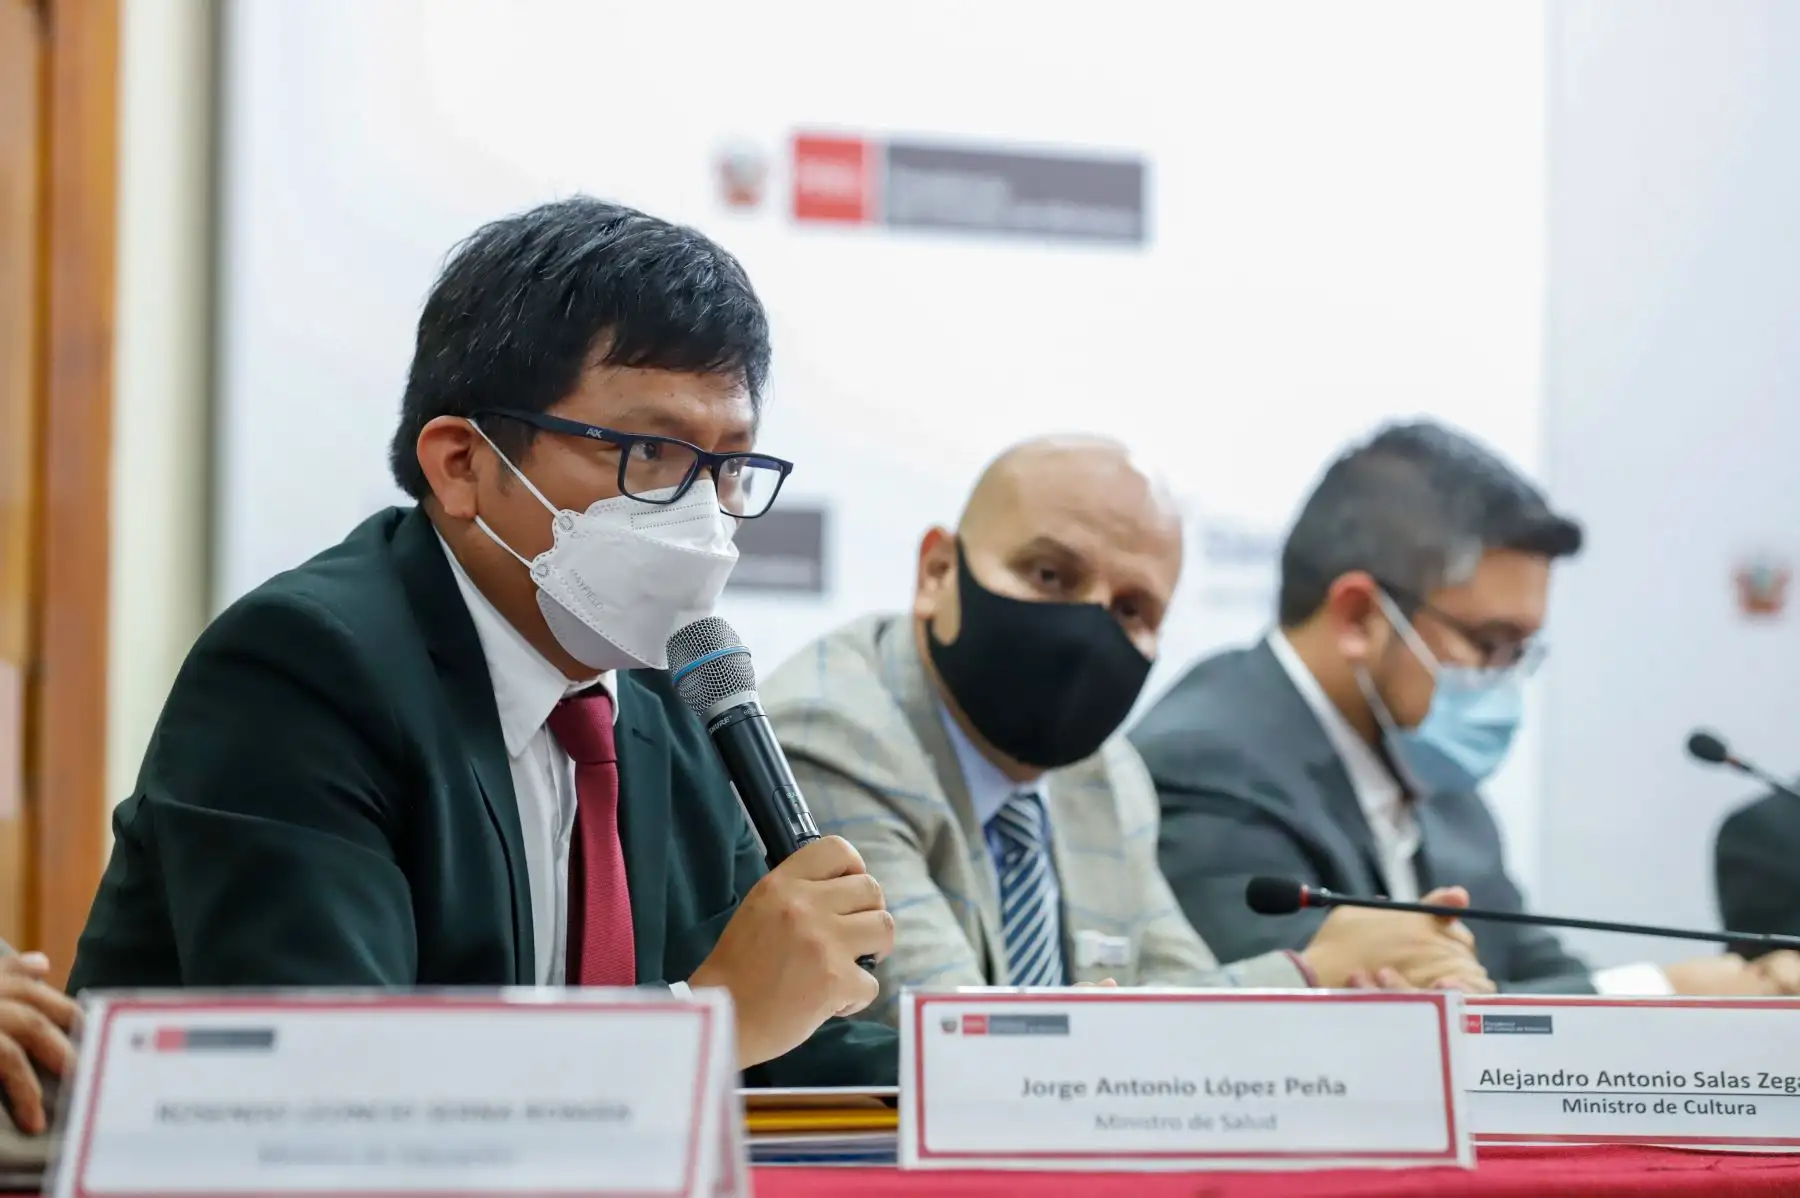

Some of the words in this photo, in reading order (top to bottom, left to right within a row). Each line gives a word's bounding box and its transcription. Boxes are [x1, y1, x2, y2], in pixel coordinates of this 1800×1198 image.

[1021, 1077, 1087, 1100] Jorge
[1096, 1076, 1197, 1097] Antonio
[1204, 1075, 1275, 1100] López
[1284, 1075, 1347, 1097] Peña
[1480, 1068, 1589, 1090] Alejandro
[1596, 1070, 1687, 1088] Antonio
[1694, 1070, 1751, 1089] Salas
[1562, 1098, 1647, 1114] Ministro
[1653, 1098, 1678, 1114] de
[1684, 1099, 1757, 1115] Cultura
[1095, 1114, 1182, 1131] Ministro
[1188, 1113, 1214, 1131] de
[1220, 1112, 1277, 1132] Salud
